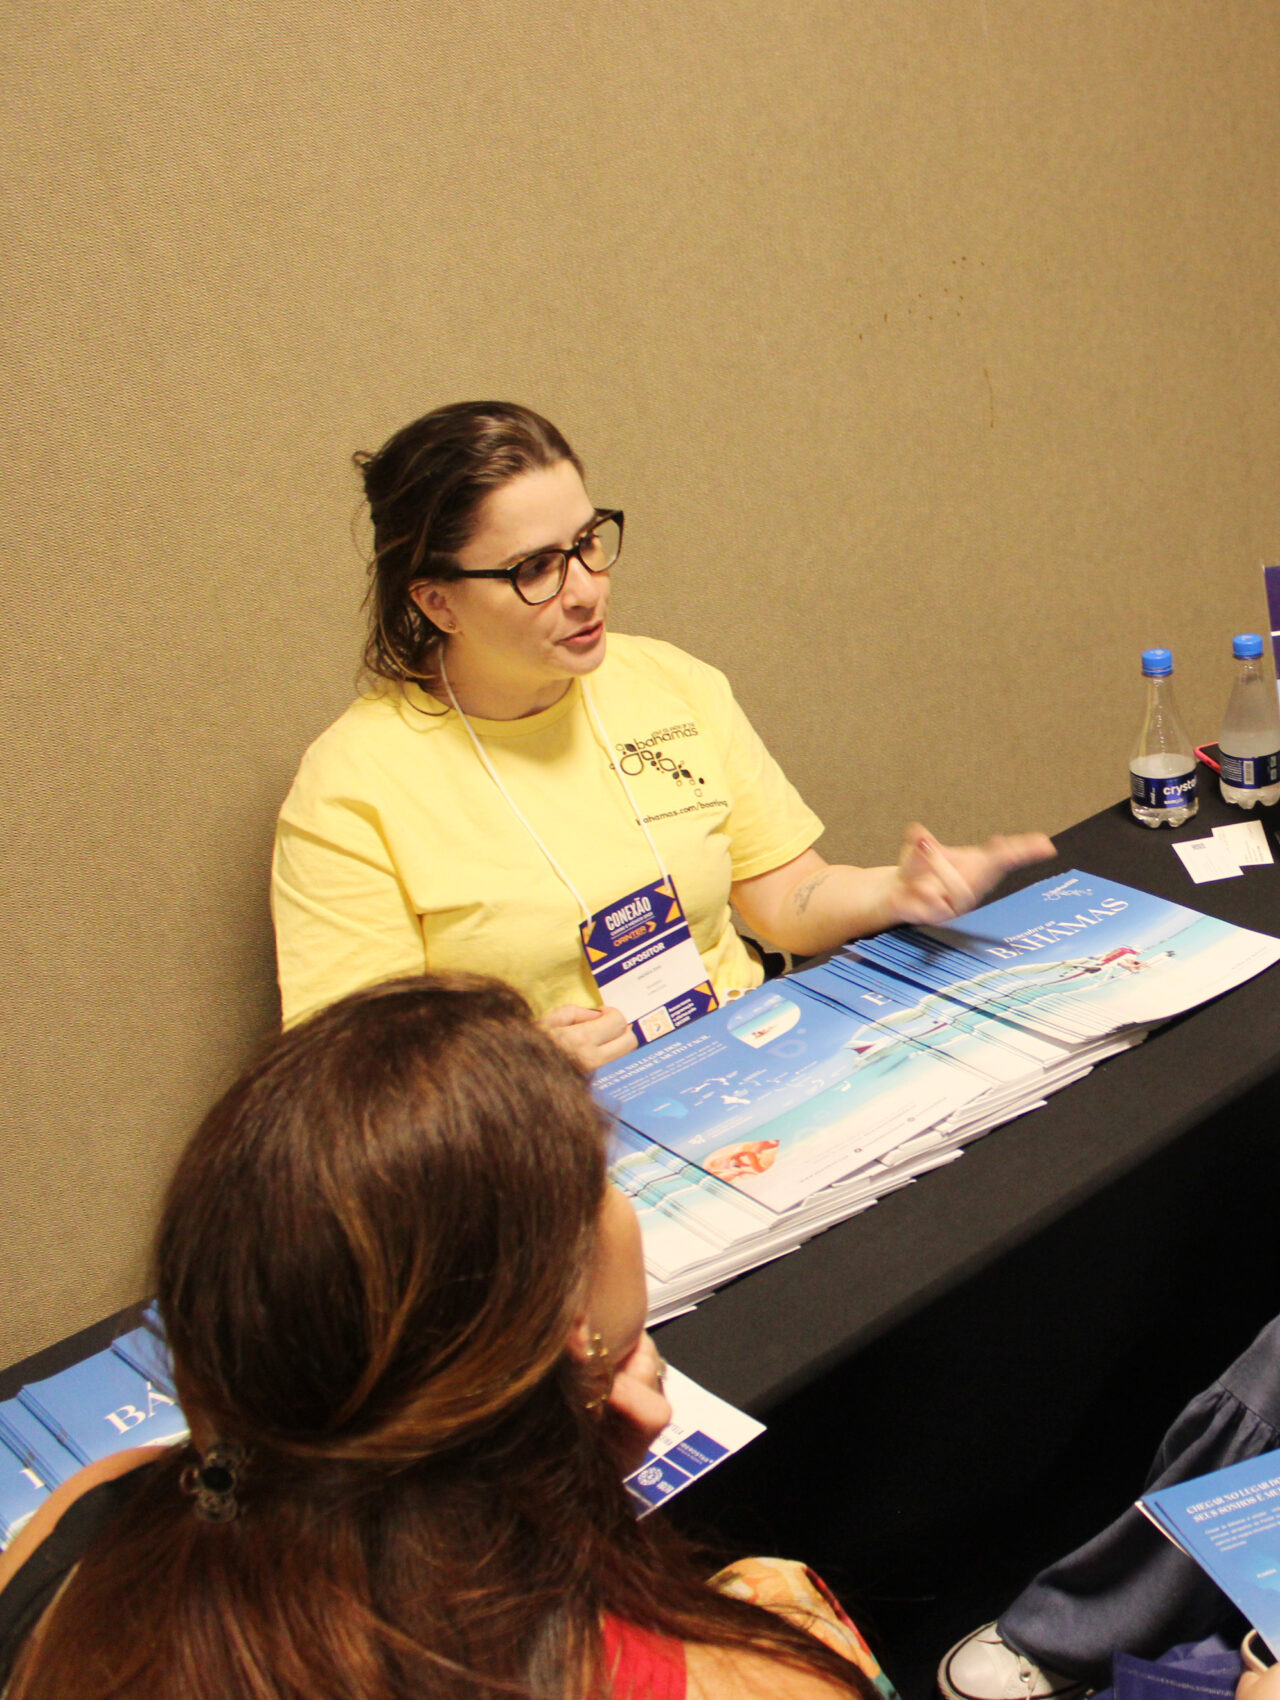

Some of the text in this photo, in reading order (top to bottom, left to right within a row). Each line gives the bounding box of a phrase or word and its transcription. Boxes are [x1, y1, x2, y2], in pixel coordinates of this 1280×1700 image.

[634, 727, 699, 750] bahamas
[604, 896, 652, 931] CONEXÃO
[985, 897, 1129, 959] BAHAMAS
[622, 942, 666, 970] EXPOSITOR
